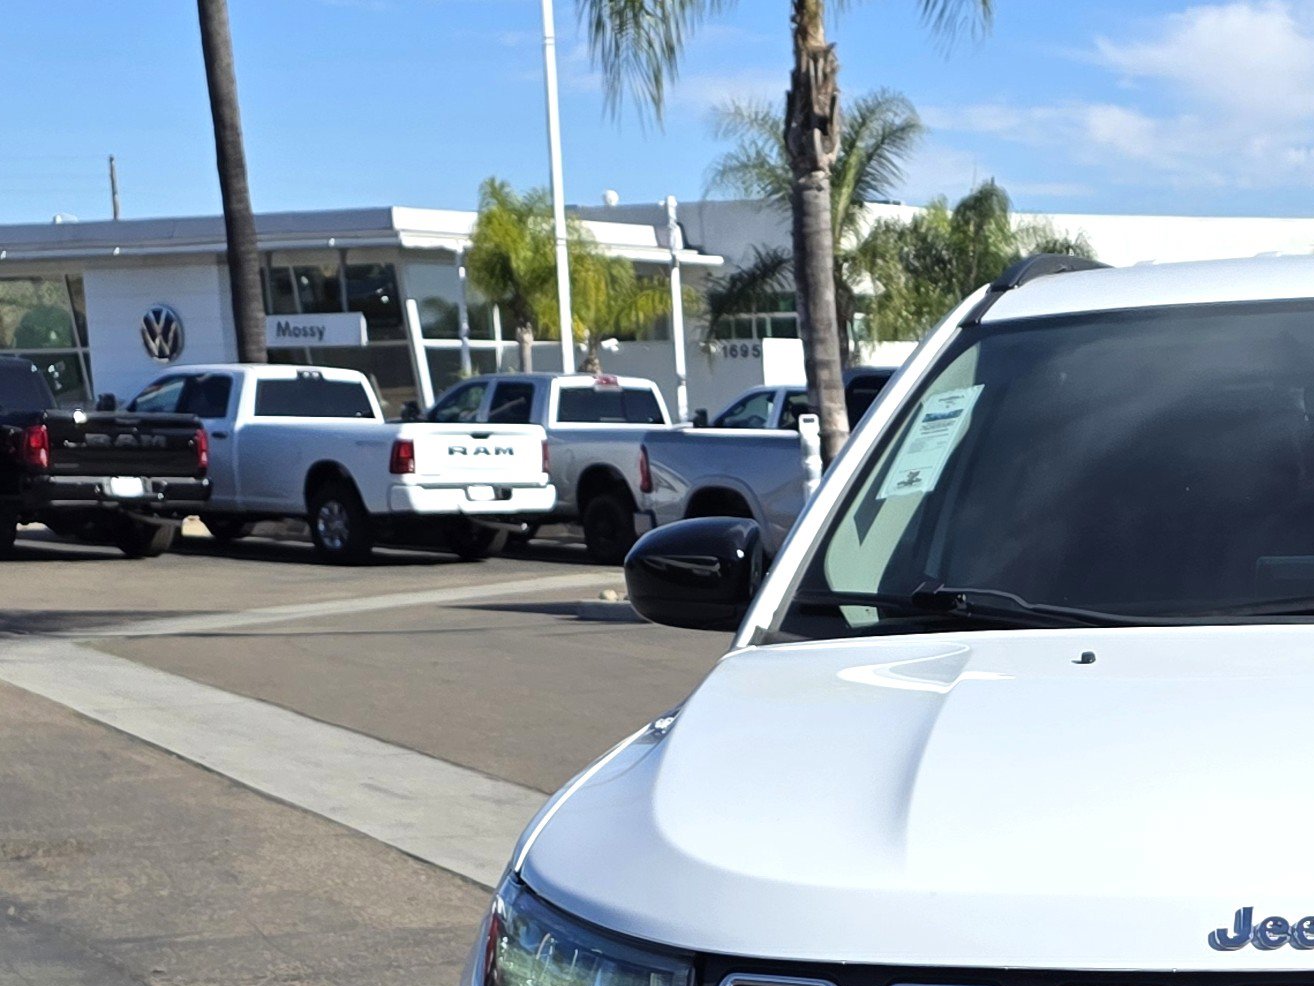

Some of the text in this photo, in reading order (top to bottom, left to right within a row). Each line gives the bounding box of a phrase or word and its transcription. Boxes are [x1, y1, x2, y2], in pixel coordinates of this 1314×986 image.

[276, 320, 326, 341] Mossy
[722, 343, 761, 359] 1695
[448, 445, 514, 456] RAM
